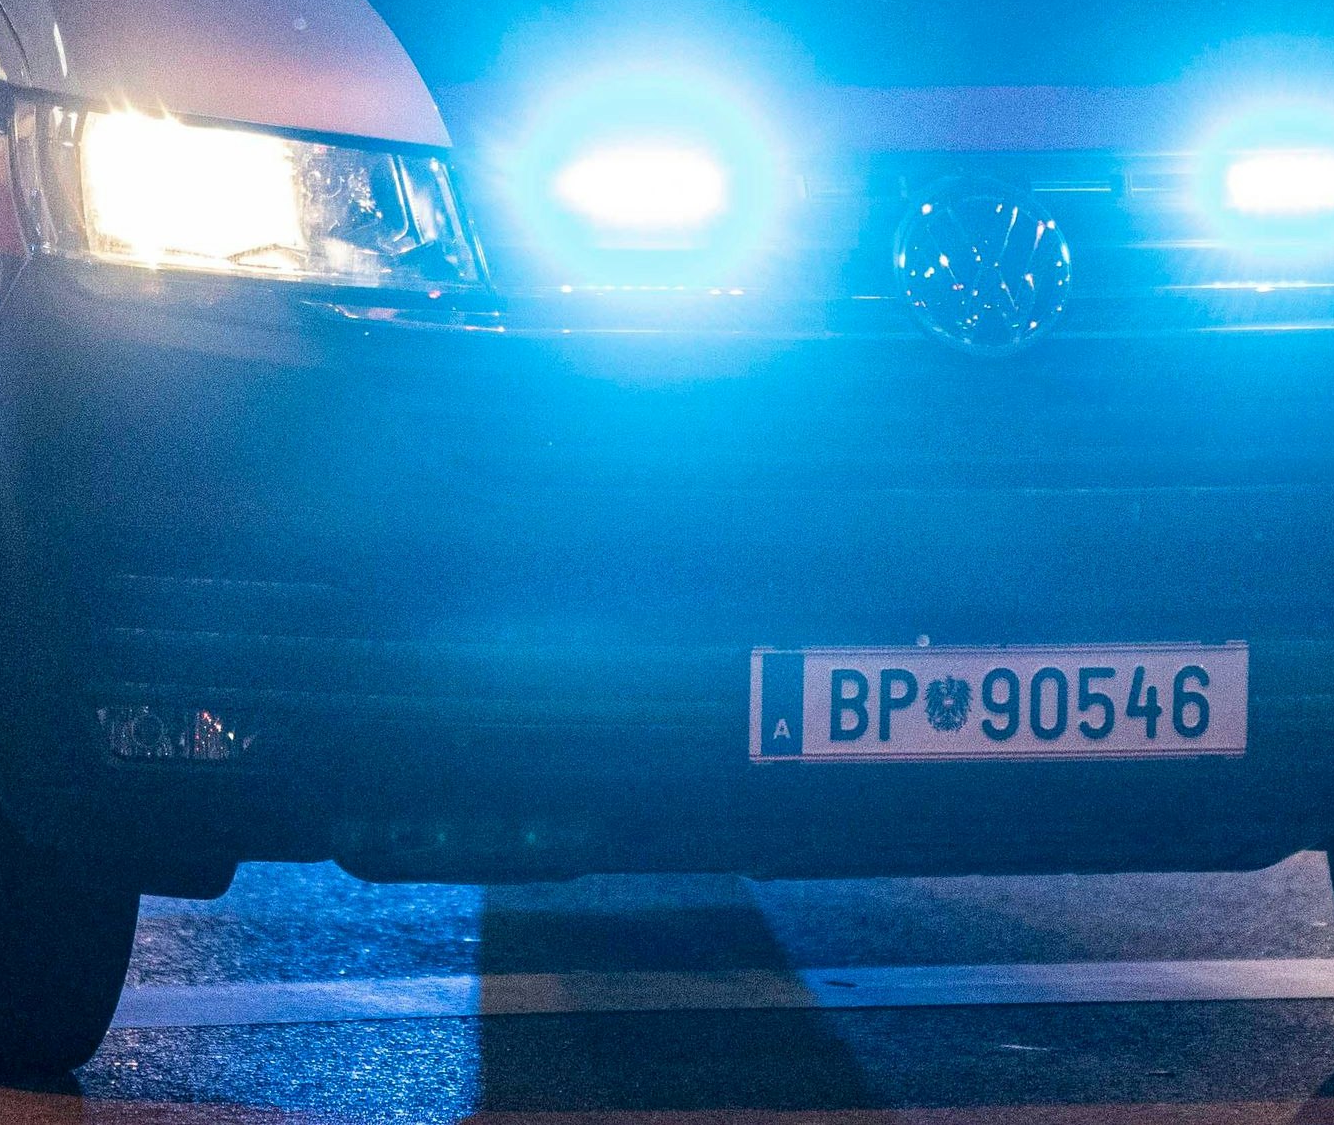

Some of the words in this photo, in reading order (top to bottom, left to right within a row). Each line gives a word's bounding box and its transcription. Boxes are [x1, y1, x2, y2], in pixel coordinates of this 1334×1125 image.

[829, 667, 918, 742] BP
[981, 664, 1210, 742] 90546
[773, 718, 792, 741] A
